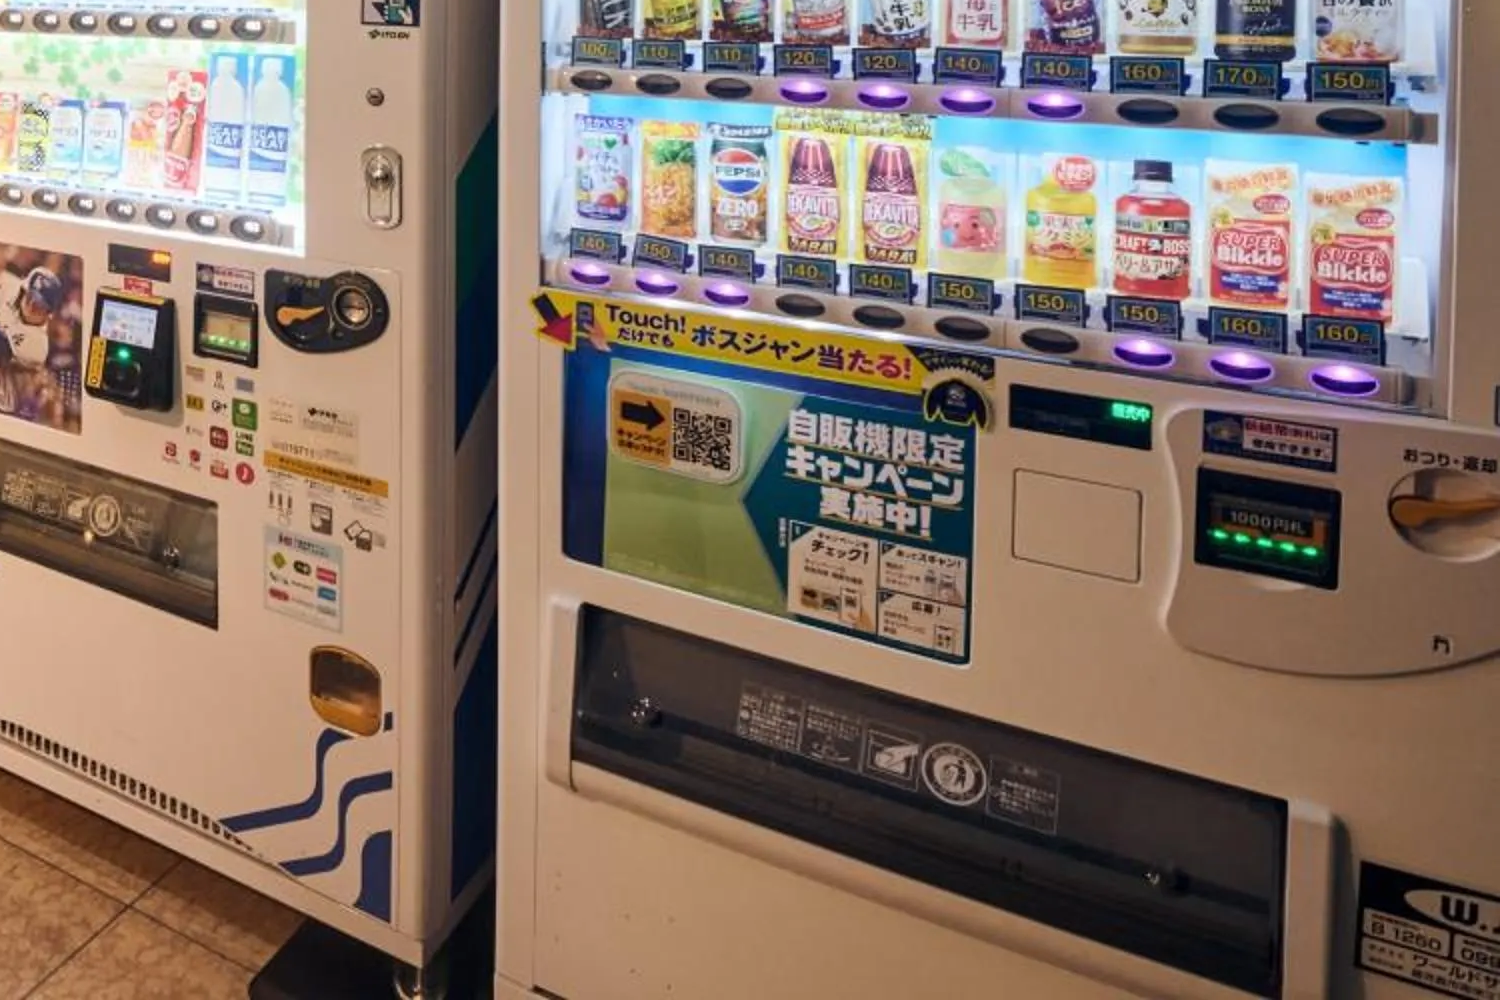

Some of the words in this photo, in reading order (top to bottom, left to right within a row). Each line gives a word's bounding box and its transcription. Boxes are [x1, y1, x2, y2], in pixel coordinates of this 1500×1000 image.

[1219, 232, 1281, 250] SUPER
[1217, 245, 1283, 268] Bikkle
[1321, 247, 1385, 266] SUPER
[1316, 260, 1387, 283] Bikkle
[605, 303, 687, 335] Touch!
[616, 326, 676, 350] だけでも
[690, 324, 913, 382] ボスジャン当たる!
[786, 408, 967, 475] 自販機限定
[784, 445, 965, 506] キャンペーン
[819, 487, 932, 539] 実施中!
[811, 539, 870, 566] チェック!
